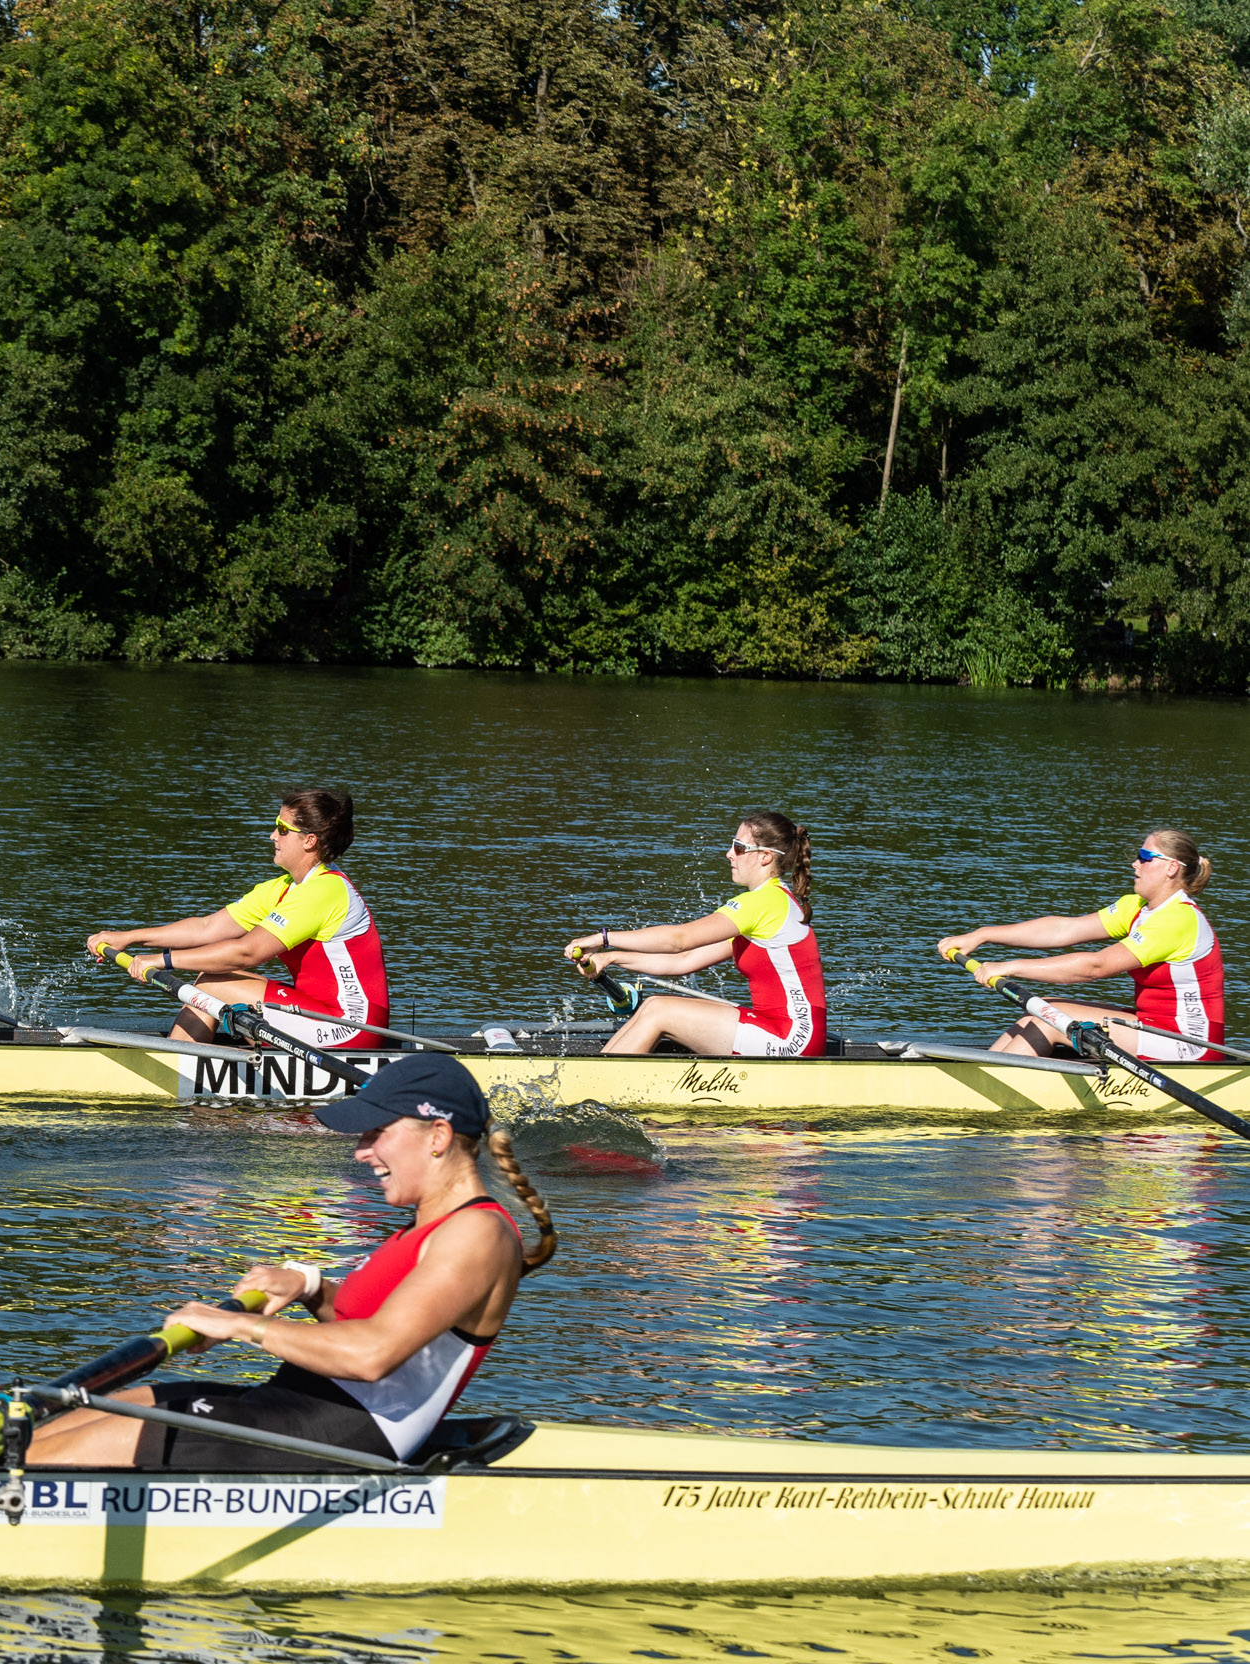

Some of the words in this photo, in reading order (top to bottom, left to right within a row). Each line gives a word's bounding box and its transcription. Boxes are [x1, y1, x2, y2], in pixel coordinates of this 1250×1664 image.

[270, 911, 286, 927] RBL
[316, 1028, 329, 1044] 8+
[765, 1041, 777, 1056] 8+
[194, 1055, 393, 1096] MINDE
[100, 1487, 436, 1515] RUDER-BUNDESLIGA
[663, 1485, 702, 1508] 175
[701, 1485, 770, 1512] Jahre
[774, 1485, 1014, 1510] Karl-Rehbein-Schule
[1016, 1486, 1096, 1510] Hanau
